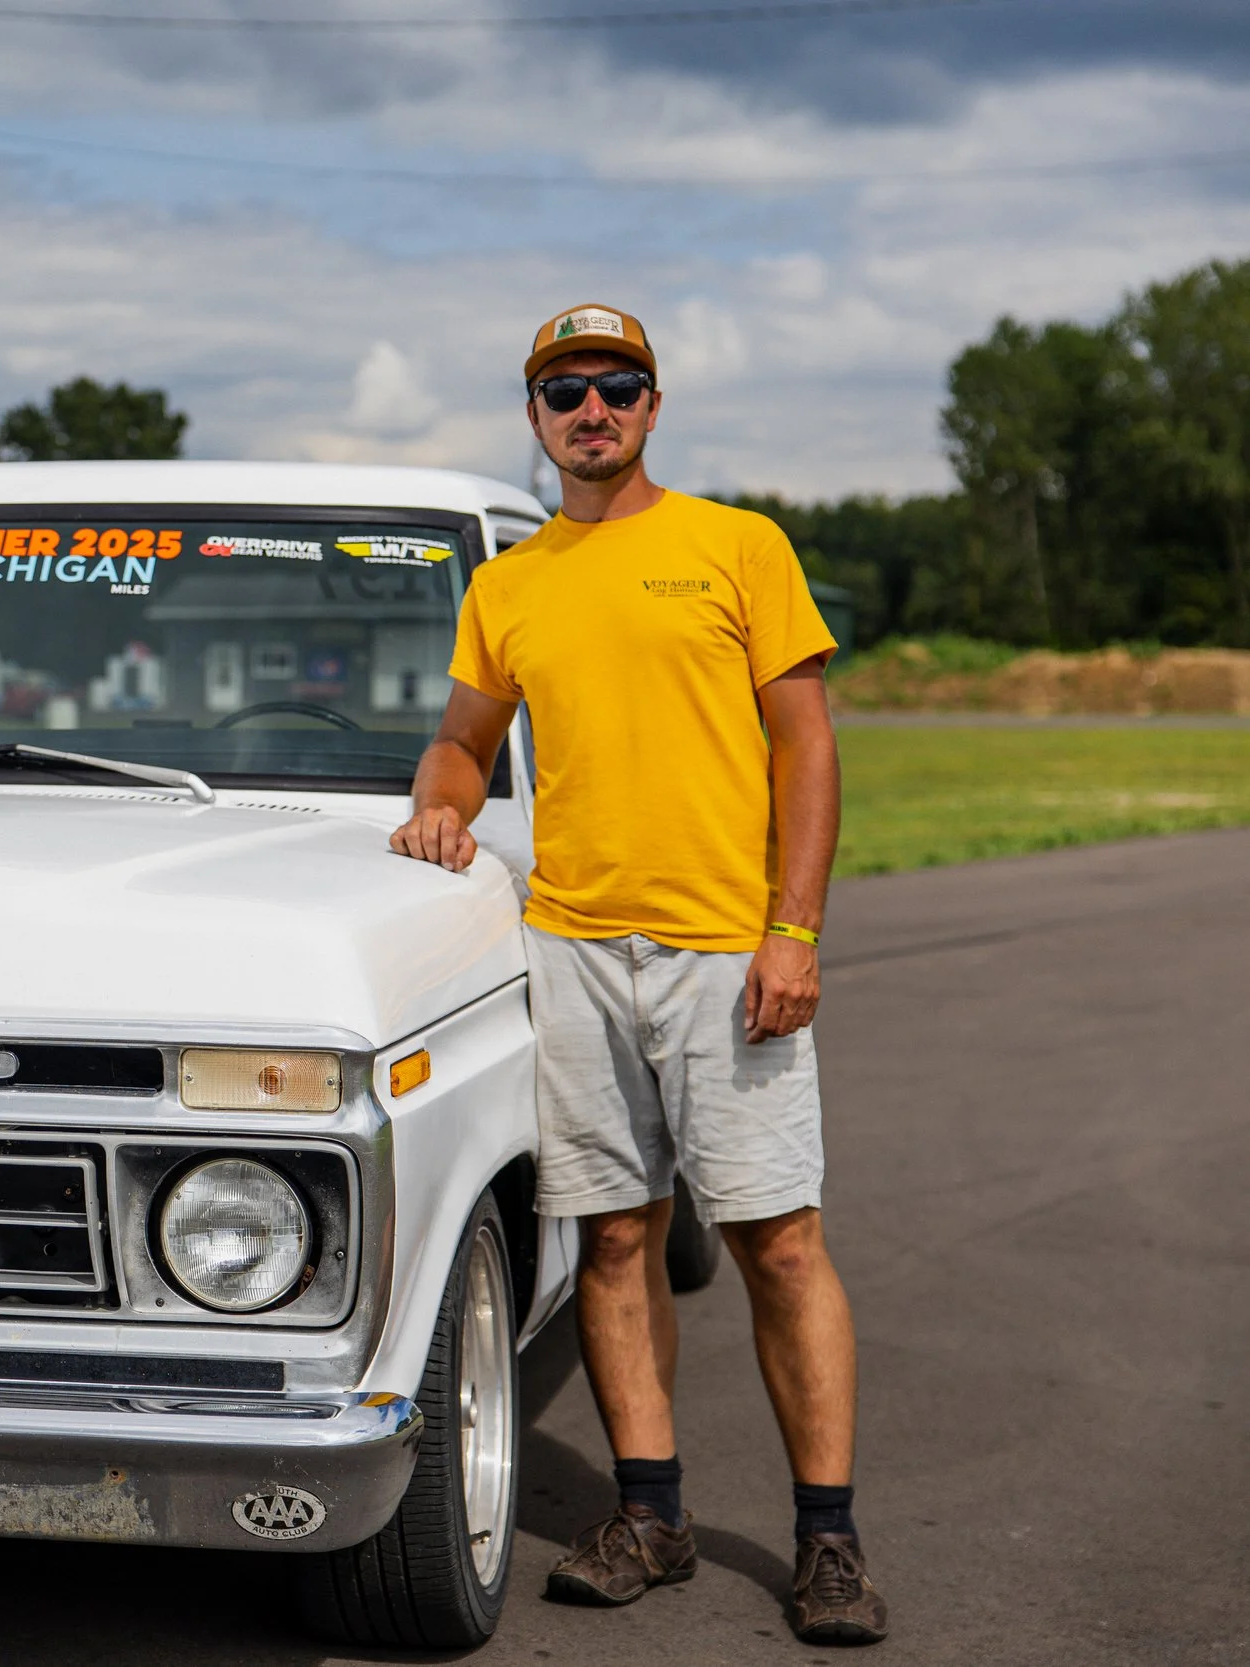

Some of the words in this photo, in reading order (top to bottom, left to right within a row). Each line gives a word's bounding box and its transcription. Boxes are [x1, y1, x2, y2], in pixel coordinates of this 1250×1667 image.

[69, 528, 183, 560] 2025
[206, 536, 322, 553] OVERDRIVE
[265, 548, 323, 561] VENDORS
[110, 584, 150, 595] MILES
[642, 580, 712, 593] VOYAGEUR
[250, 1496, 310, 1528] AAA
[253, 1526, 279, 1537] AUTO
[281, 1527, 307, 1537] CLUB
